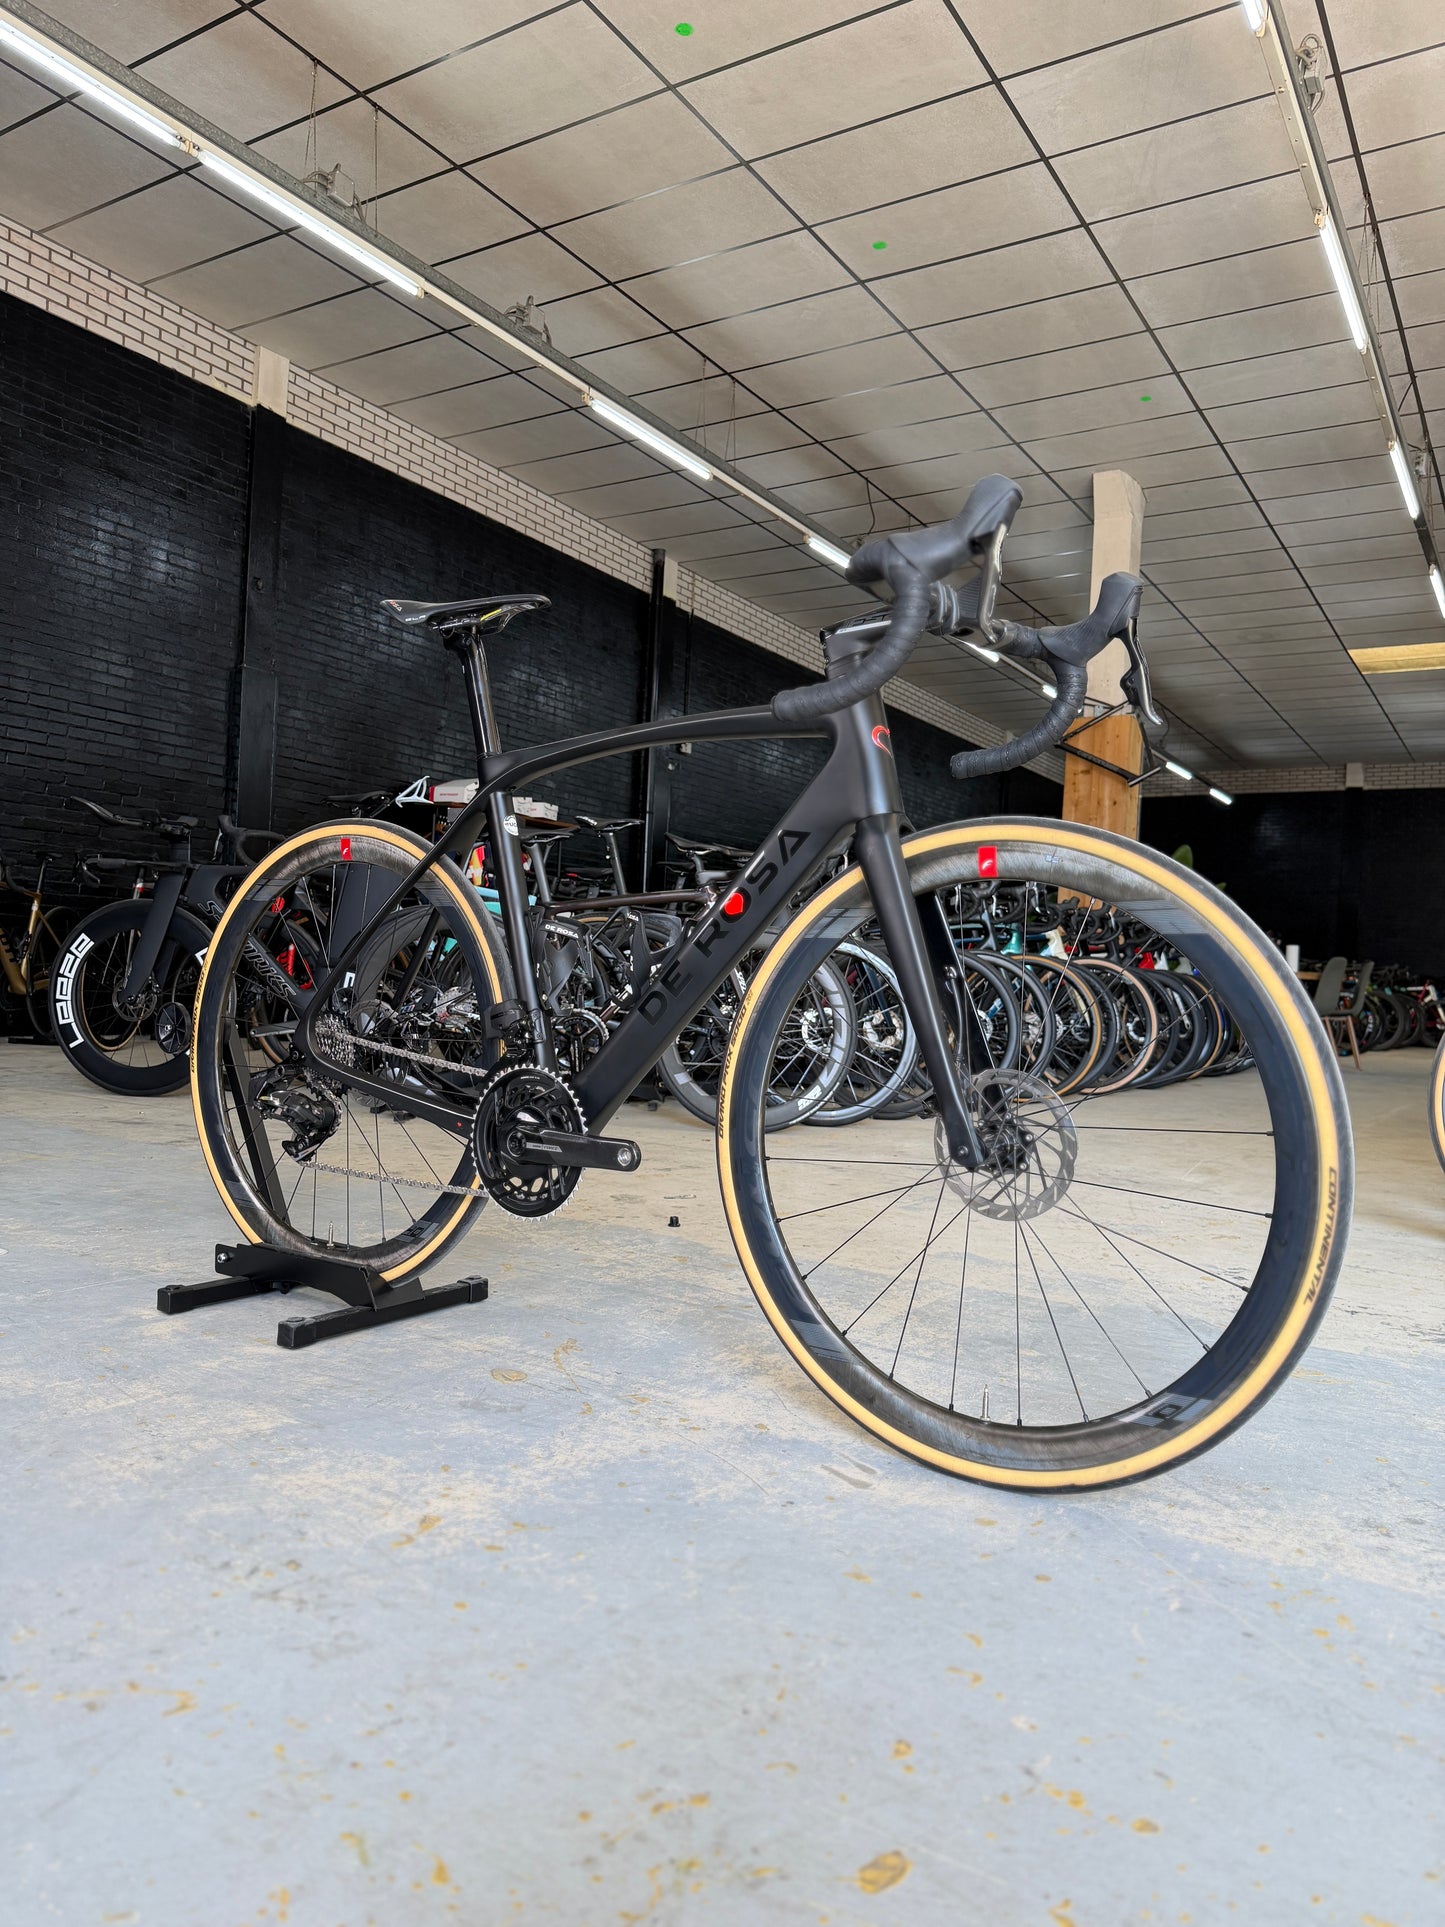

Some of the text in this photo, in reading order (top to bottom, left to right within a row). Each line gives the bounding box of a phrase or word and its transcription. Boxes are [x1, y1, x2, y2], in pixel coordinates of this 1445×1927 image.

[544, 923, 579, 939] DE ROSA
[638, 829, 812, 1026] DE ROSA
[730, 1006, 748, 1048] 5000
[722, 1050, 733, 1086] PRIX
[718, 1086, 727, 1139] GRAND
[1303, 1166, 1337, 1305] CONTINENTAL
